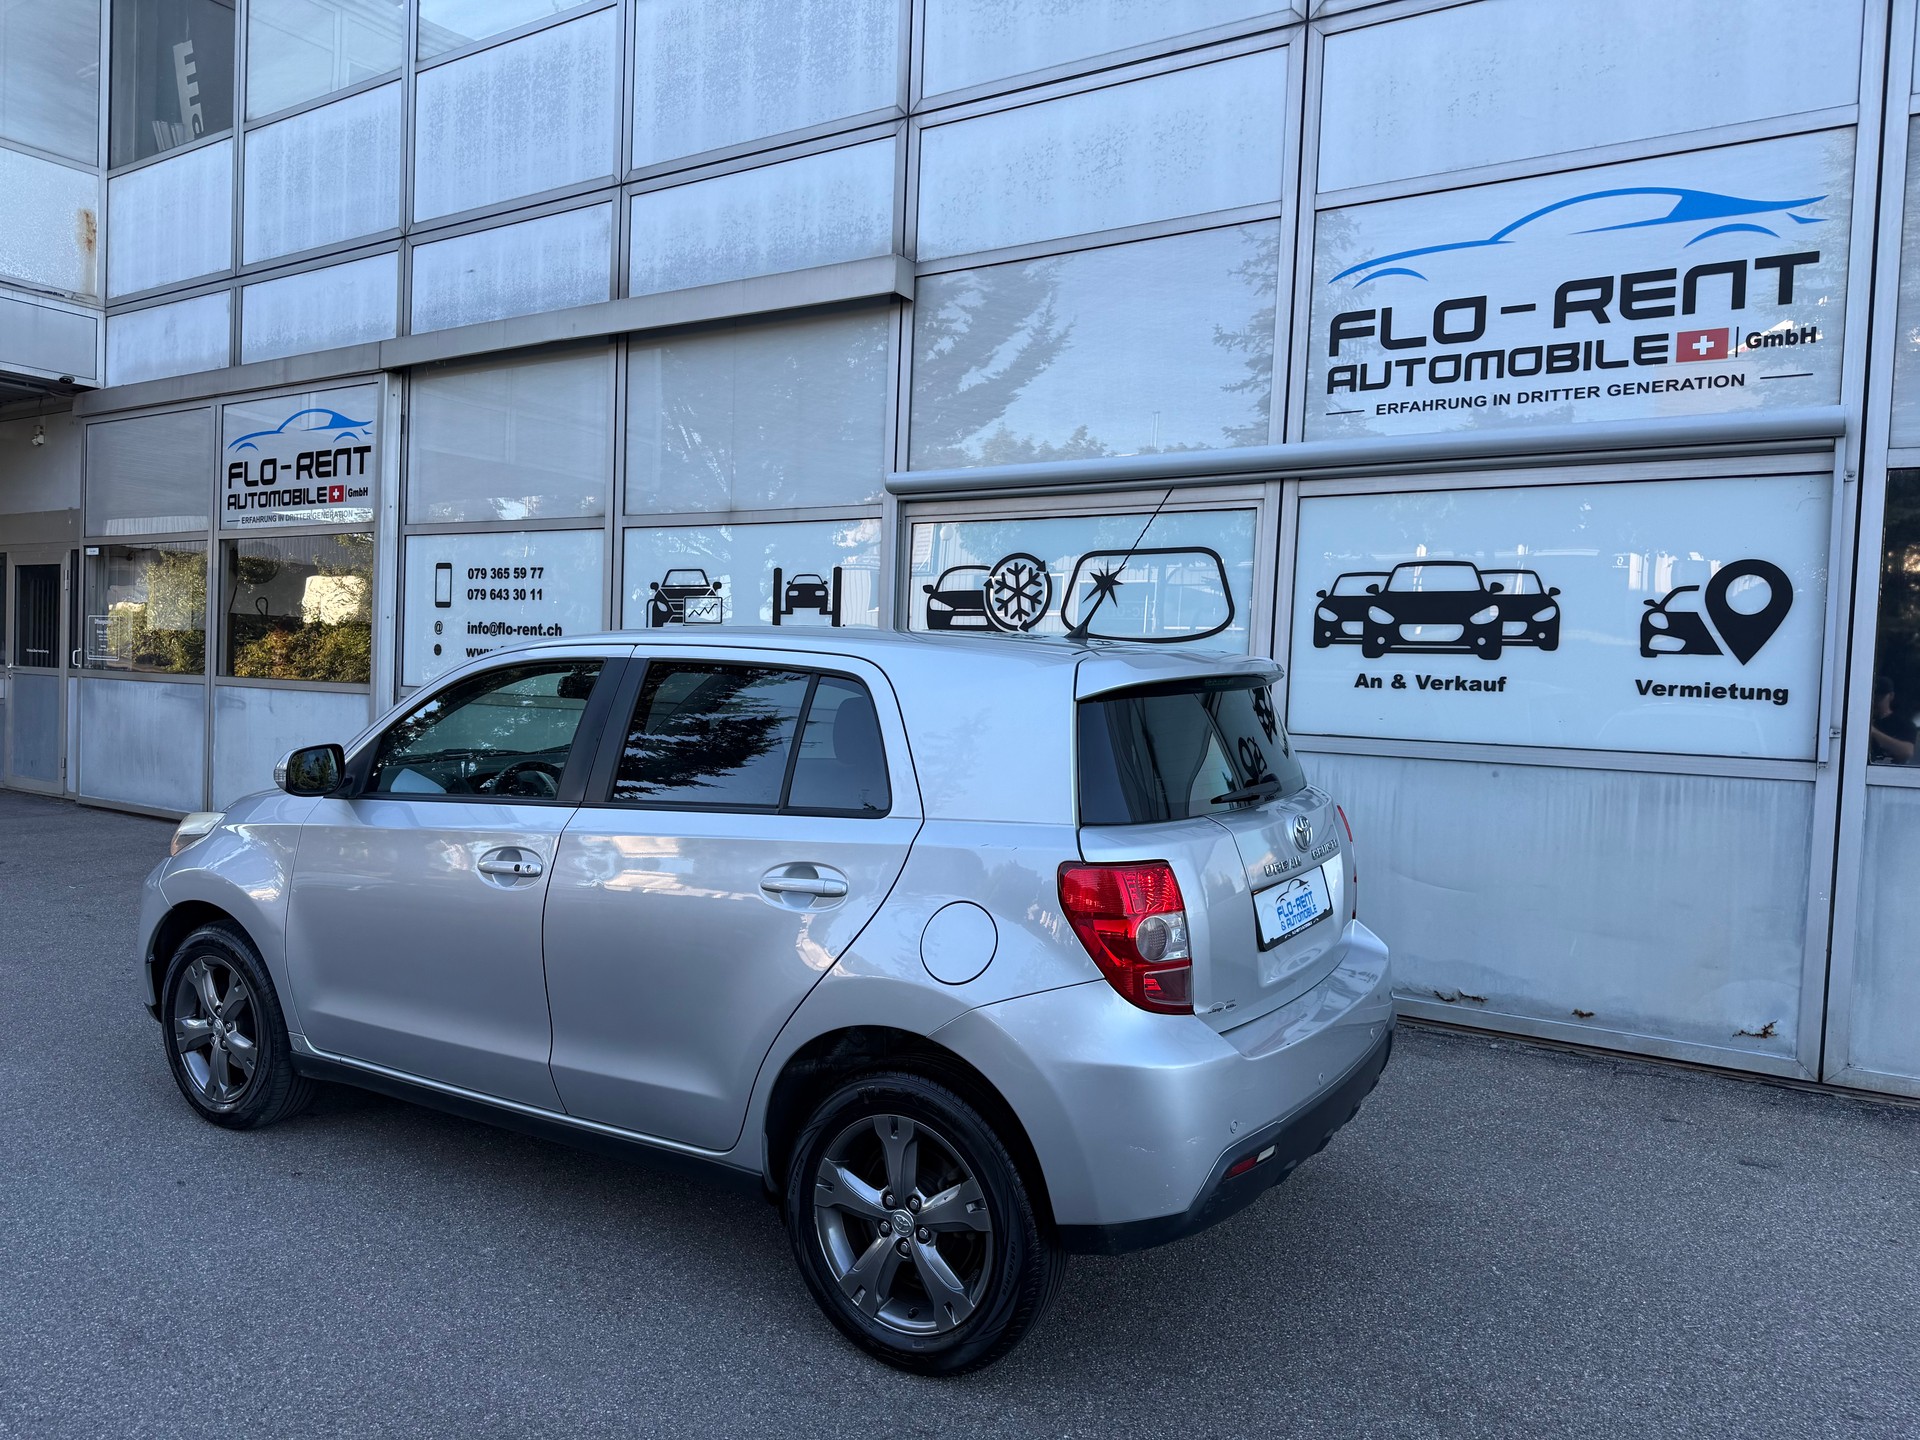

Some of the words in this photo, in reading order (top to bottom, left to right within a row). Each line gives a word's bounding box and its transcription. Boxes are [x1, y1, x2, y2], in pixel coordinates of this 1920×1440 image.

[1327, 333, 1669, 395] AUTOMOBILE
[1745, 326, 1817, 349] GmbH
[1376, 395, 1487, 415] ERFAHRUNG
[1493, 393, 1511, 405] IN
[1517, 385, 1600, 404] DRITTER
[1606, 374, 1745, 398] GENERATION
[228, 487, 327, 510] AUTOMOBILE
[348, 487, 368, 497] GmbH
[242, 515, 276, 524] ERFAHRUNG
[468, 568, 487, 580] 079
[490, 568, 510, 579] 365
[513, 568, 527, 579] 59
[530, 567, 544, 579] 77
[468, 589, 486, 600] 079
[490, 589, 510, 600] 643
[513, 589, 526, 600] 30
[530, 589, 542, 600] 11
[467, 622, 562, 637] info@flo-rent.ch
[1354, 674, 1382, 689] An
[1391, 675, 1406, 689] &
[1416, 675, 1507, 692] Verkauf
[1636, 679, 1788, 705] Vermietung
[1277, 891, 1314, 920] FLO-RENT
[1281, 922, 1286, 931] &
[1287, 905, 1317, 928] AUTOMOBILE
